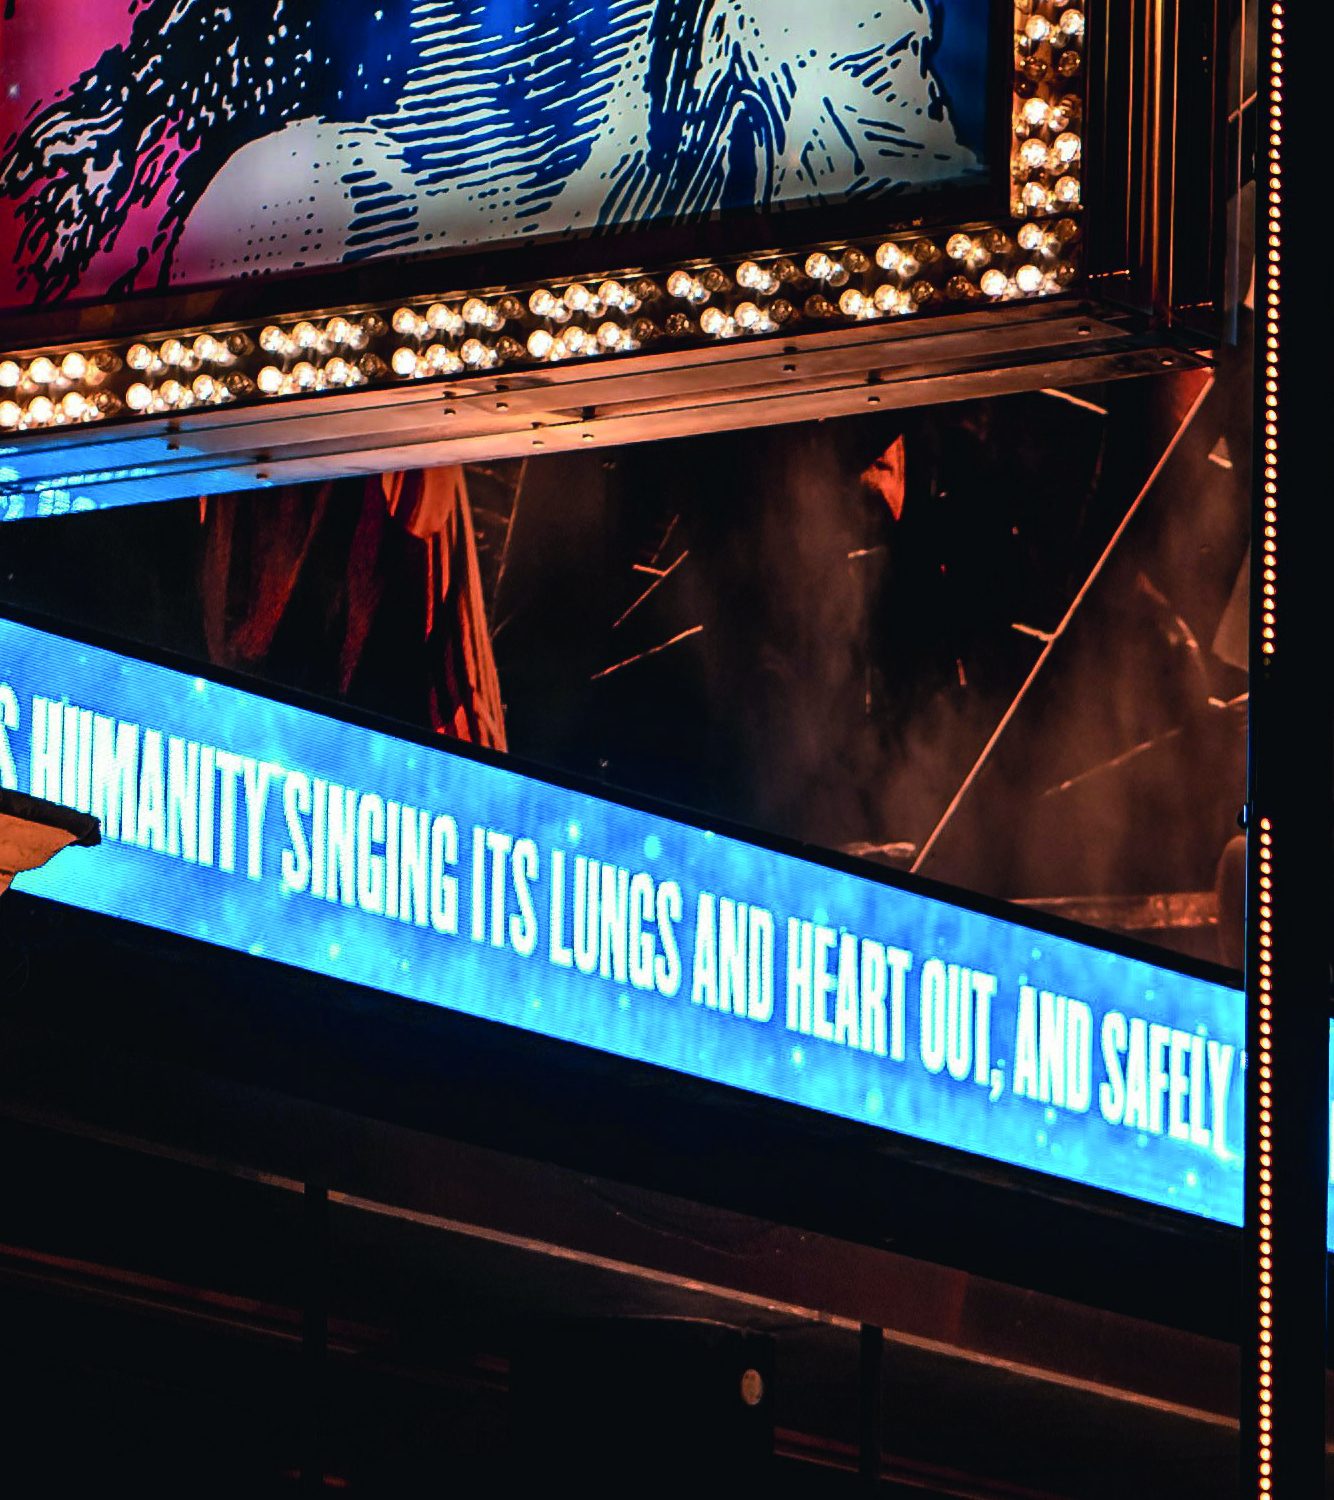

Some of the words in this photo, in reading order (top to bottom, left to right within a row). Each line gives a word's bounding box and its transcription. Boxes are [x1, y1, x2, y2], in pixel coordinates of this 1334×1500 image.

[29, 695, 279, 881] HUMANITY
[281, 772, 459, 936] SINGING
[471, 825, 539, 956] ITS
[549, 850, 682, 997] LUNGS
[692, 892, 774, 1024] AND
[785, 916, 913, 1061] HEART
[920, 957, 1005, 1101] OUT,
[1013, 986, 1092, 1113] AND
[1099, 1010, 1235, 1163] SAFELY
